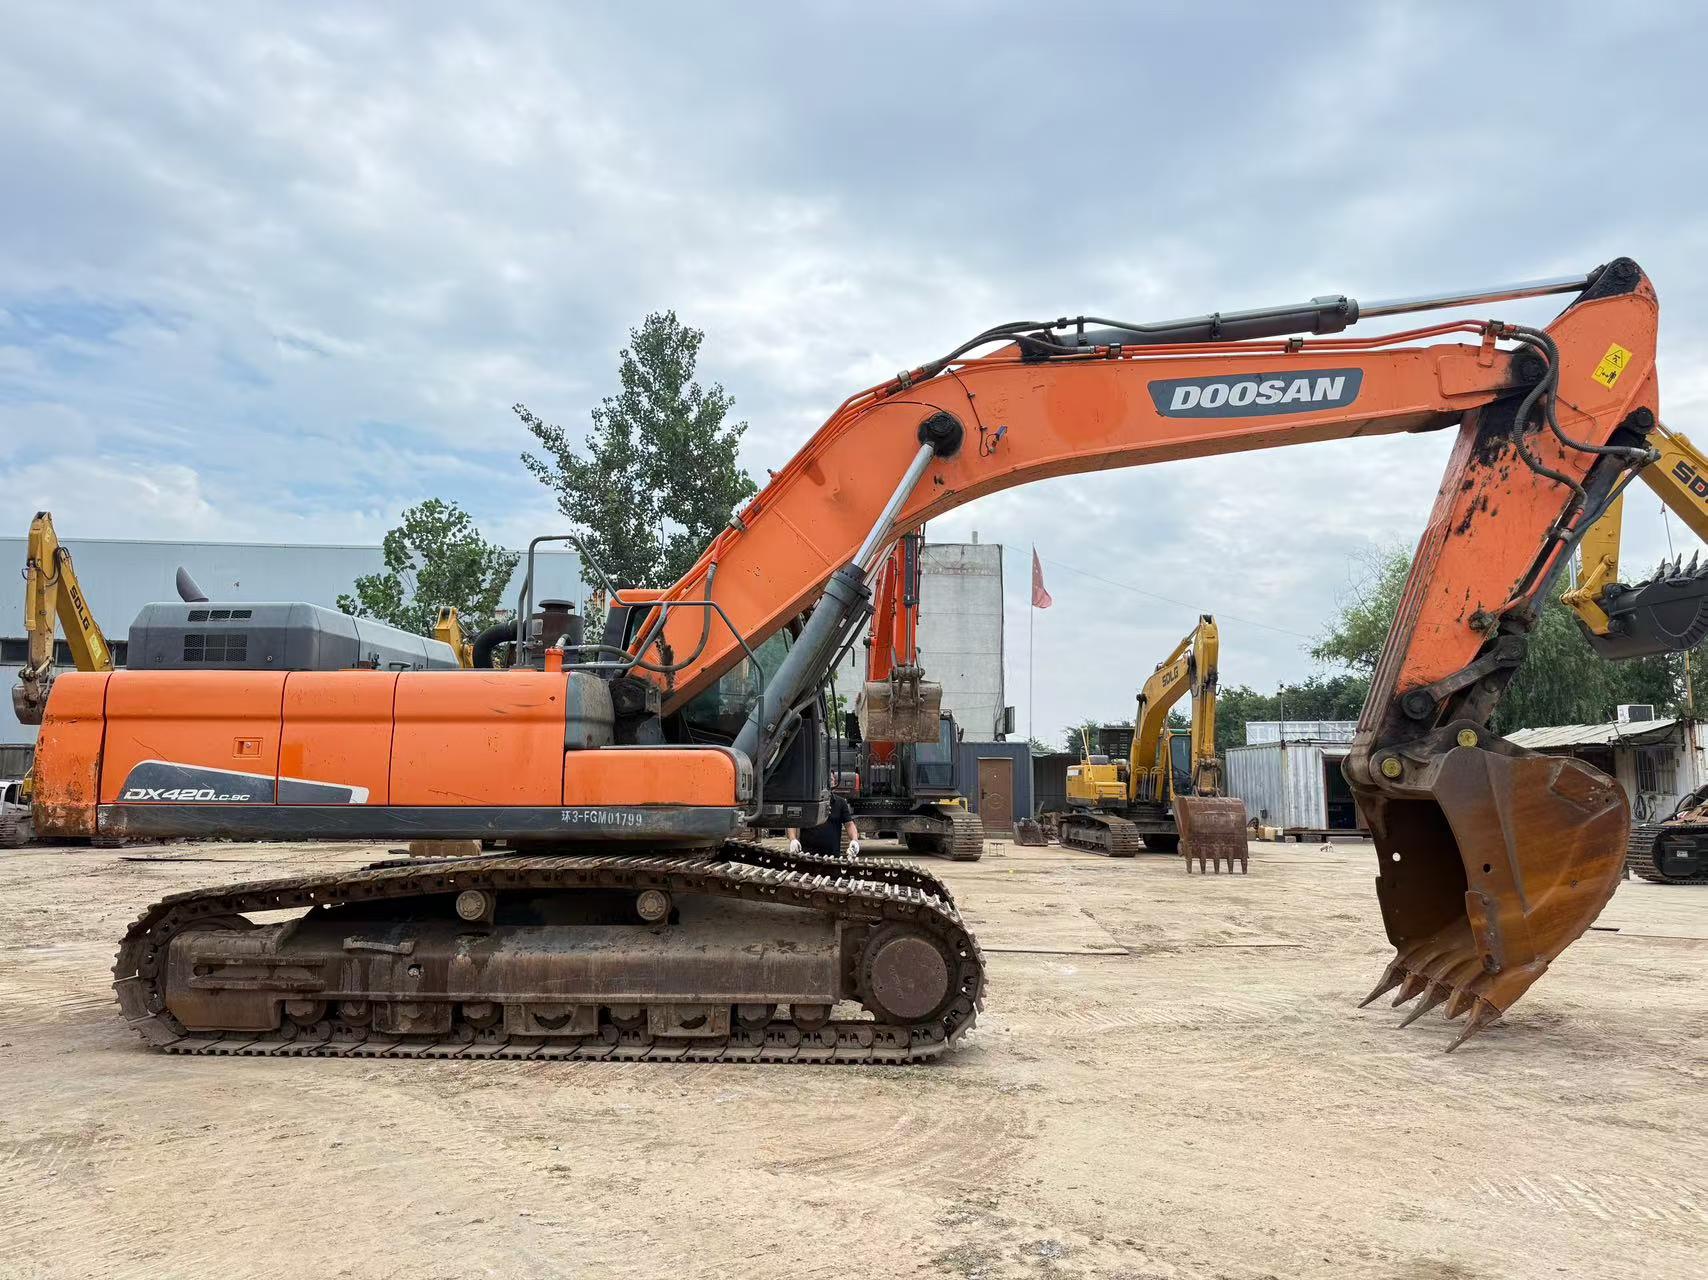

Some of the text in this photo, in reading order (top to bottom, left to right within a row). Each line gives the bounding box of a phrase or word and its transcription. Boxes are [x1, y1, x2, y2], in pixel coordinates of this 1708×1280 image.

[1169, 376, 1346, 411] DOOSAN
[1671, 460, 1708, 504] SD
[69, 584, 91, 631] SDLG
